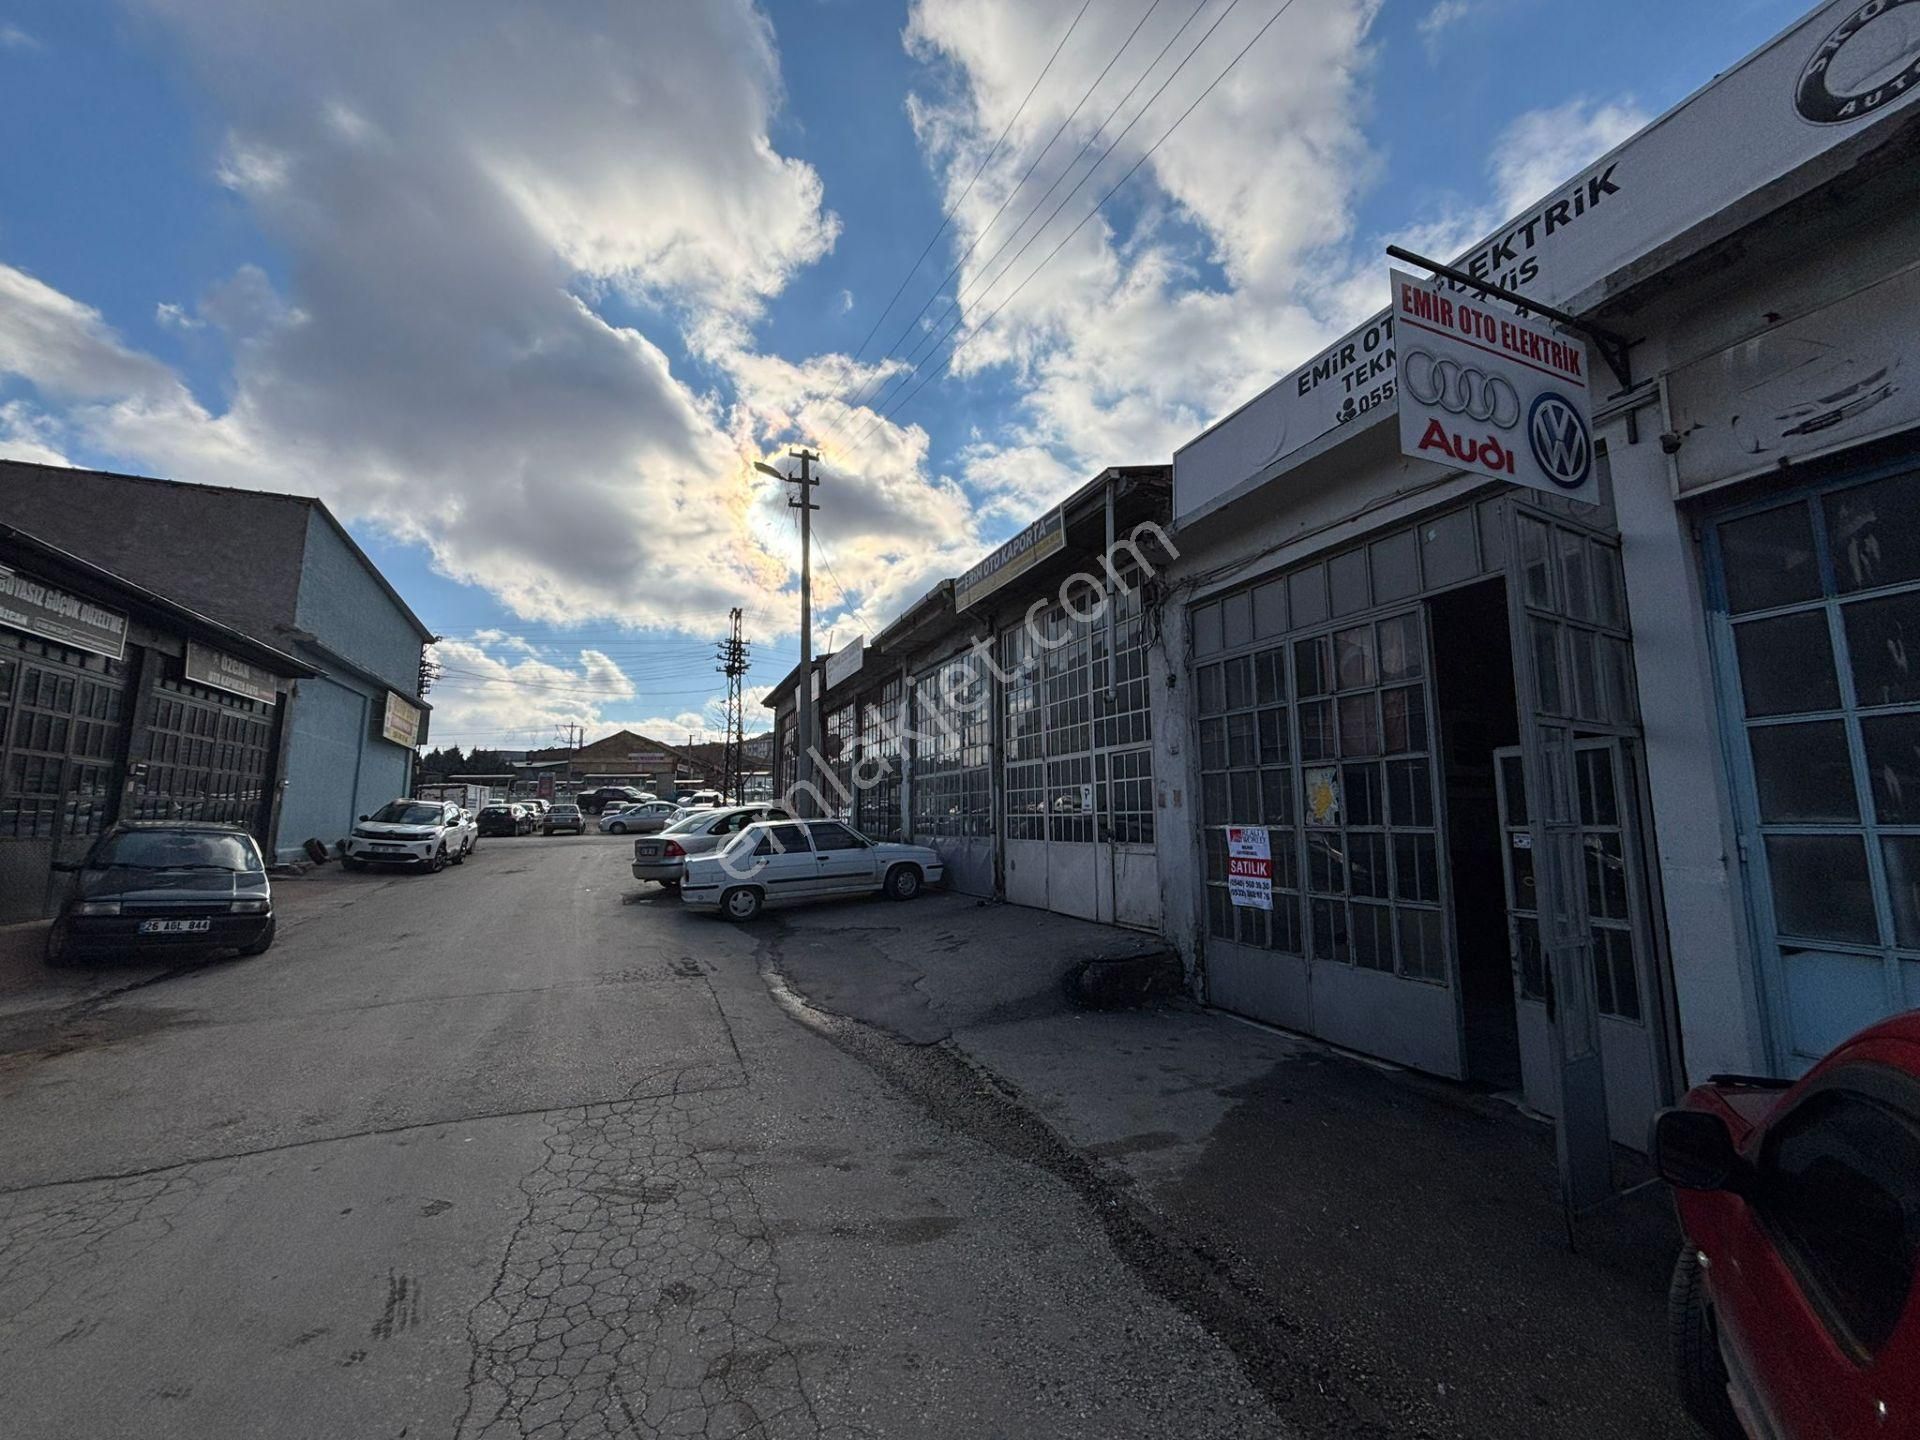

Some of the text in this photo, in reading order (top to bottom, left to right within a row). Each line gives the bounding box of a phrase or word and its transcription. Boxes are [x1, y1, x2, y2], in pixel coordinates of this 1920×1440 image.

[1363, 315, 1394, 353] OT
[1401, 282, 1582, 377] EMİR OTO ELEKTRİK
[1341, 348, 1397, 393] TEKN
[1418, 417, 1515, 475] Audi
[983, 553, 1000, 575] OTO
[1001, 519, 1047, 566] KAPORTA
[1230, 860, 1267, 876] SATILIK
